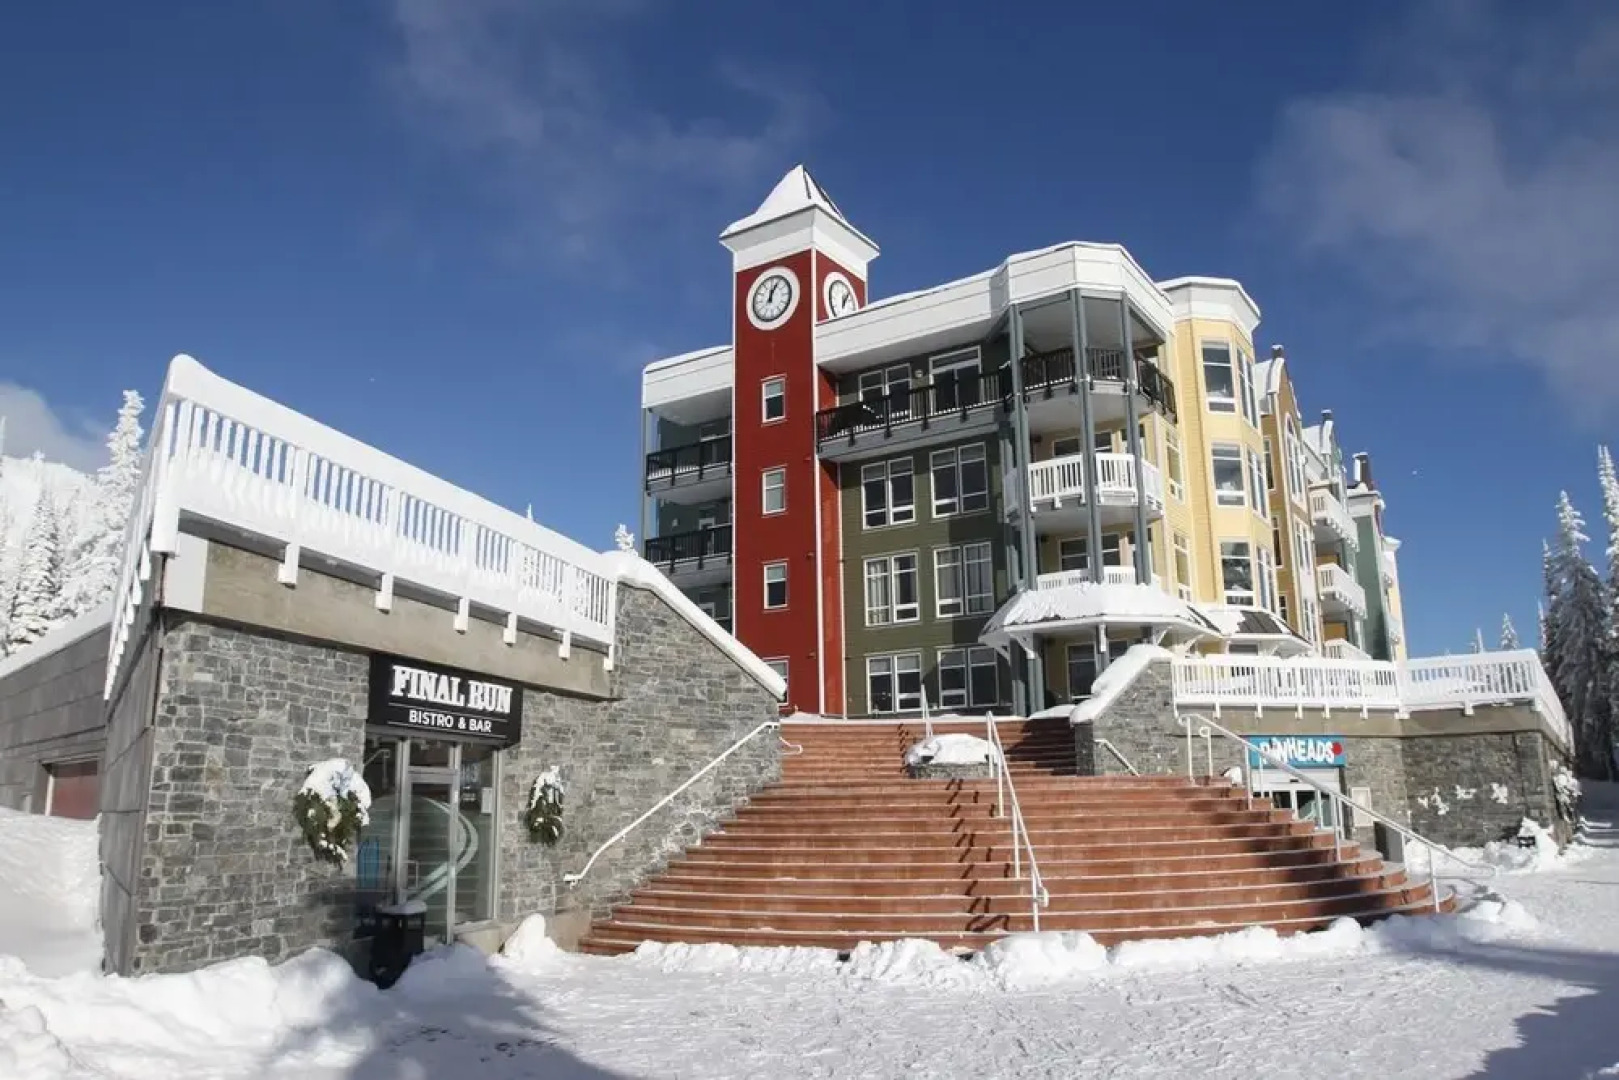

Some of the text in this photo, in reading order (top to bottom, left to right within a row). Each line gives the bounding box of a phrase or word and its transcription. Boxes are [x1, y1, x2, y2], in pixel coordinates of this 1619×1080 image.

[391, 665, 513, 713] FINAL RUN
[409, 710, 492, 733] BISTRO & BAR
